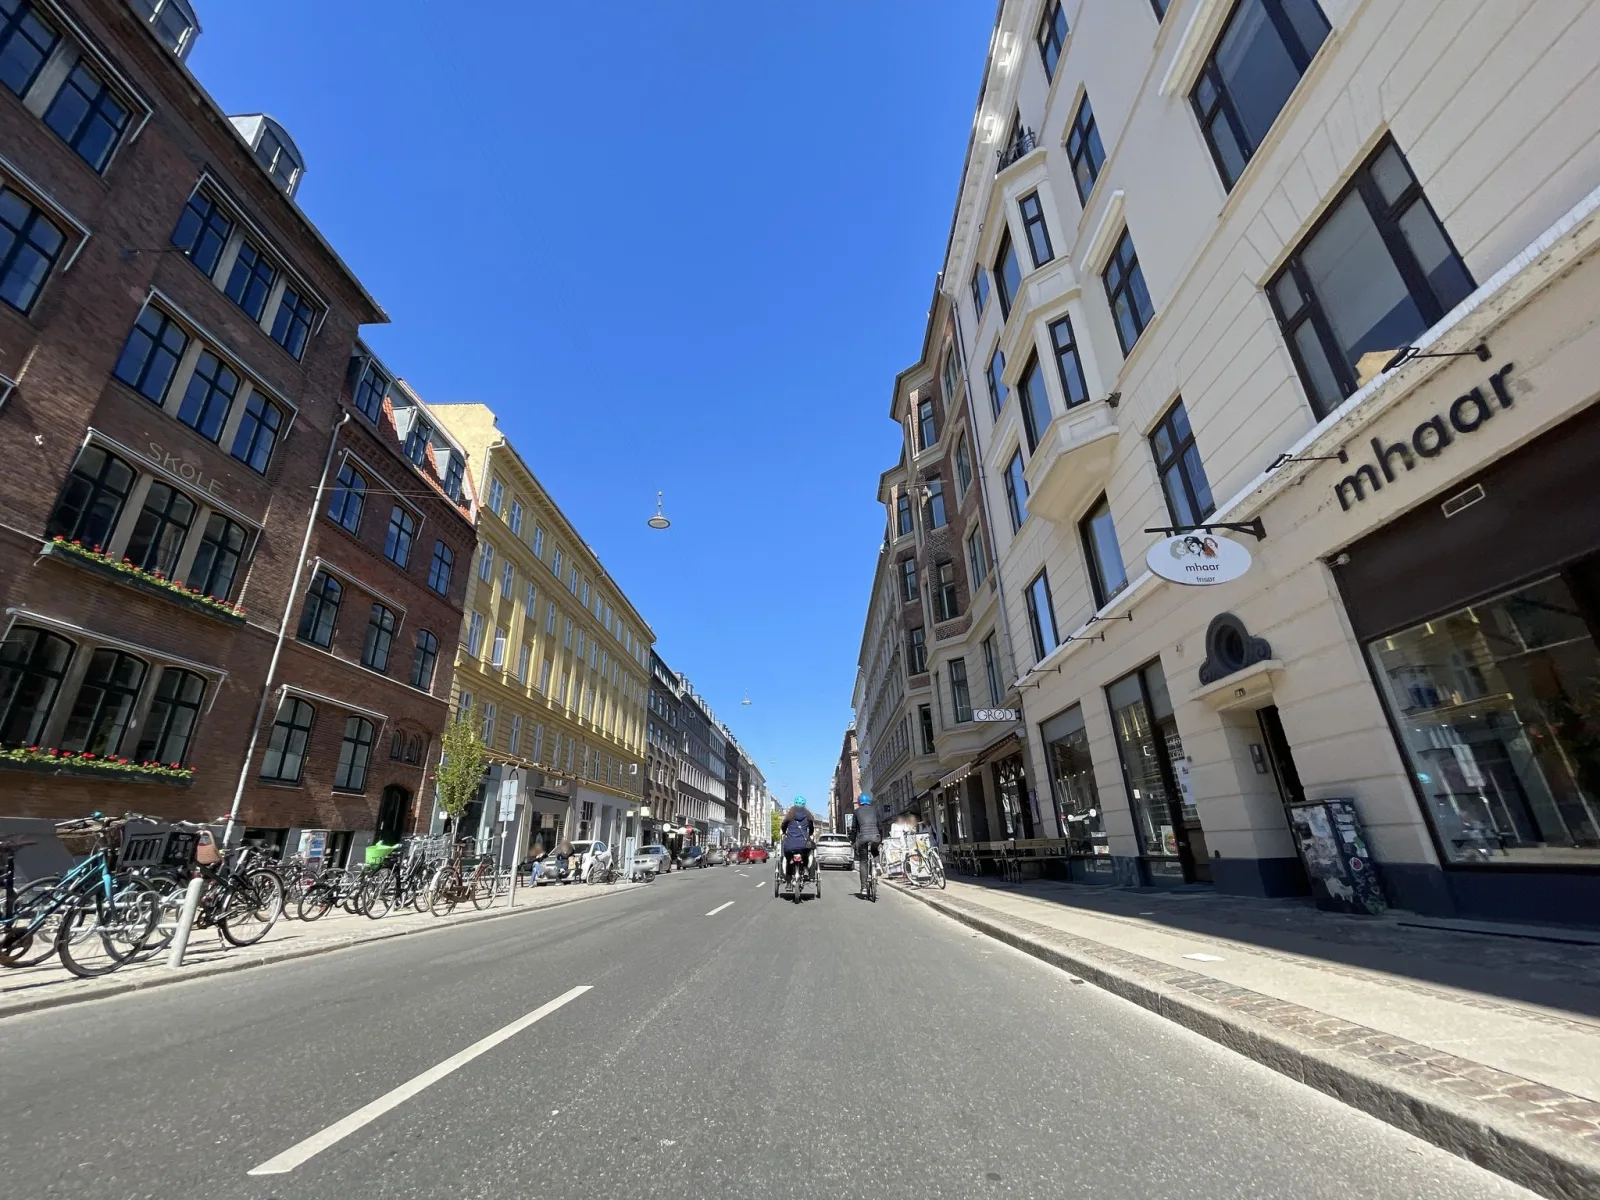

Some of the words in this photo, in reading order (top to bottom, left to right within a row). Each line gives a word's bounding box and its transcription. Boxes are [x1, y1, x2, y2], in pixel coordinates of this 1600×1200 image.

[1334, 362, 1514, 512] mhaar
[147, 442, 224, 497] SKOLE
[1185, 563, 1219, 571] mhaar
